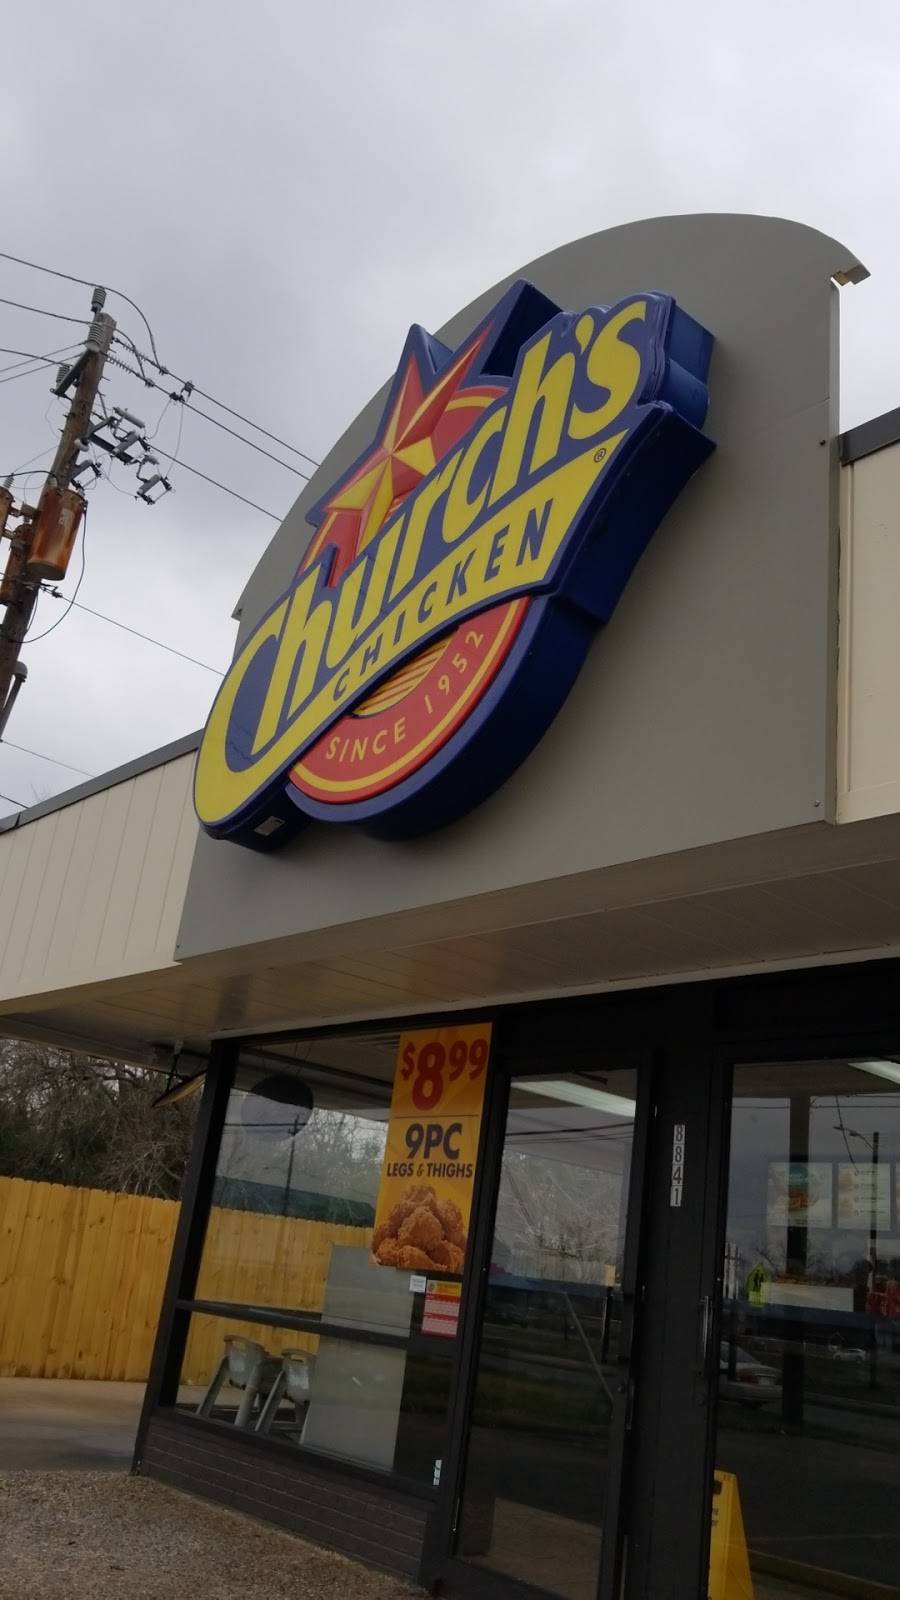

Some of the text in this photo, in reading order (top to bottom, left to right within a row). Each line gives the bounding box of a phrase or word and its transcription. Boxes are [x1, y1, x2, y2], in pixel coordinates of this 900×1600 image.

[194, 300, 648, 822] Church's
[333, 498, 555, 702] CHICKEN
[325, 630, 485, 761] SINCE 1952
[386, 1162, 474, 1179] LEGS & THIGHS
[405, 1122, 463, 1160] 9PC
[671, 1124, 685, 1206] 8841
